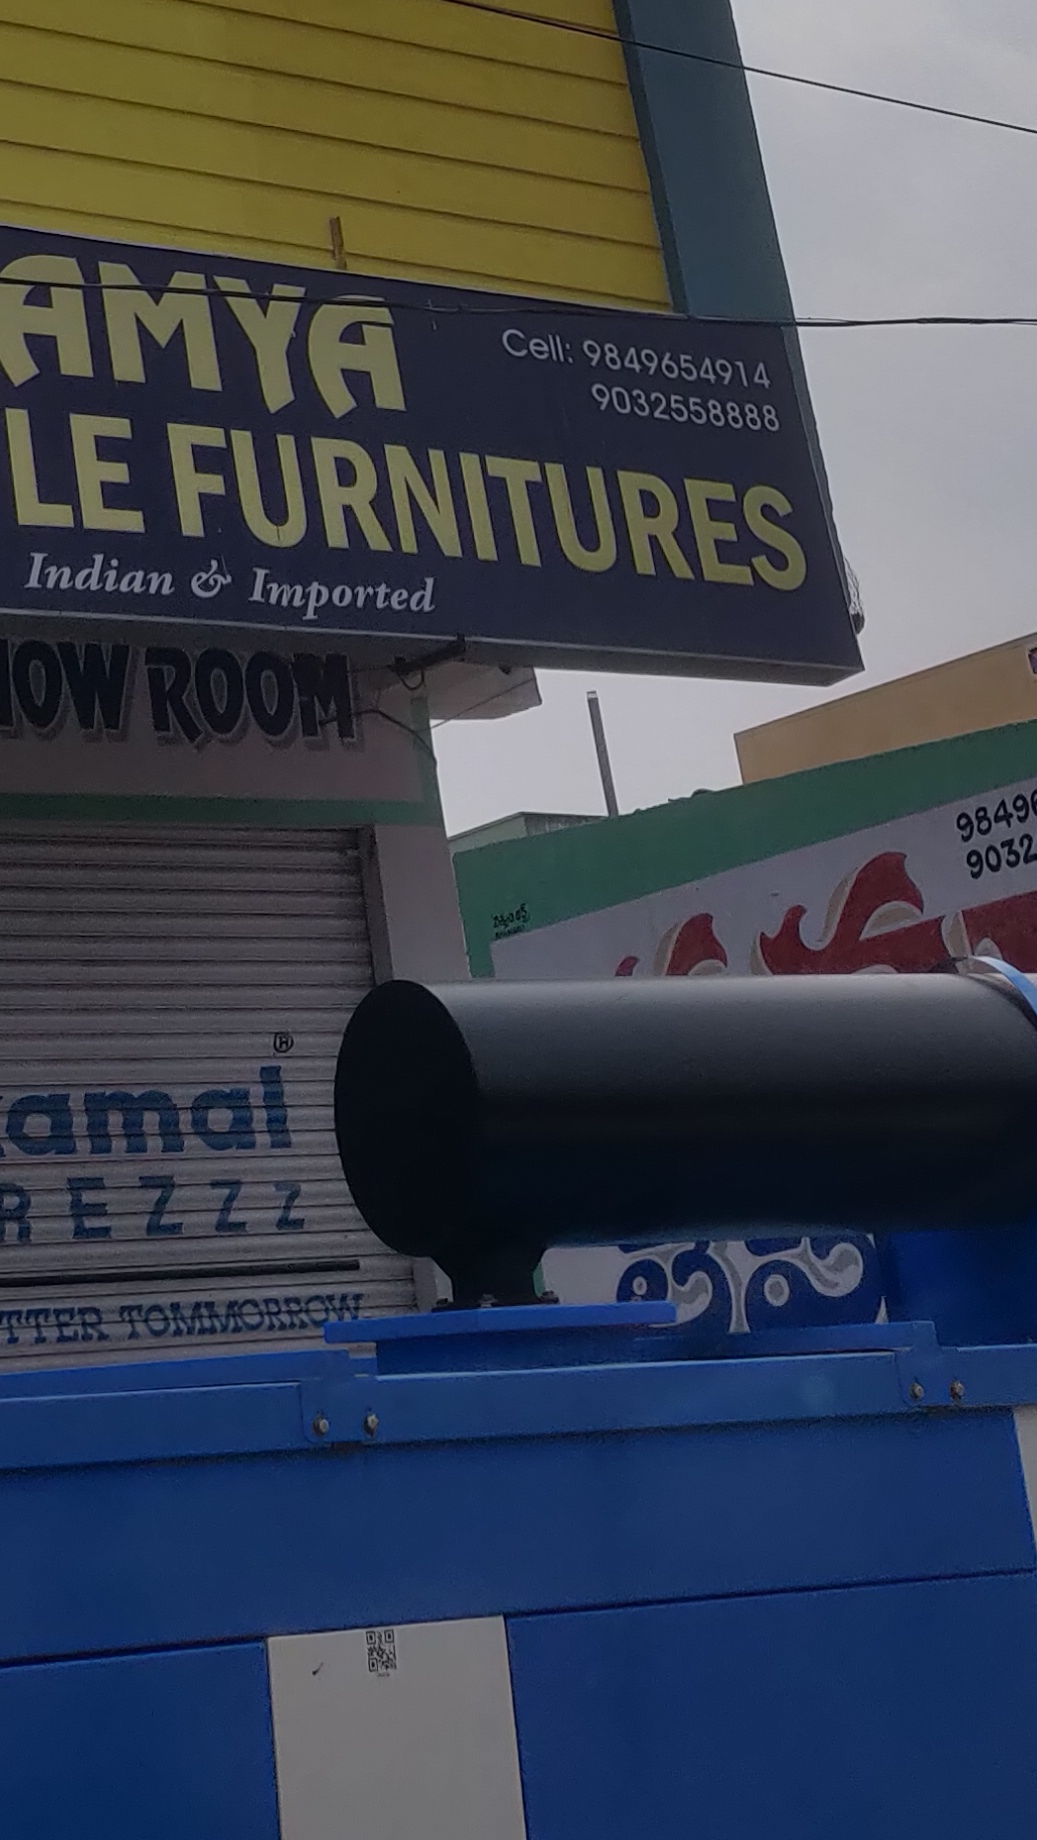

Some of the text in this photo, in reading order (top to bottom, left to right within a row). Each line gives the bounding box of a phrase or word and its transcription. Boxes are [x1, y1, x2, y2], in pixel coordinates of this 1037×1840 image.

[501, 328, 771, 390] Cell: 9849654914
[590, 382, 780, 432] 9032558888
[166, 421, 807, 592] FURNITURES
[24, 551, 436, 619] Indian & Imported
[145, 647, 359, 746] ROOM
[967, 833, 1037, 880] 9032
[118, 1292, 364, 1339] TOMMORROW
